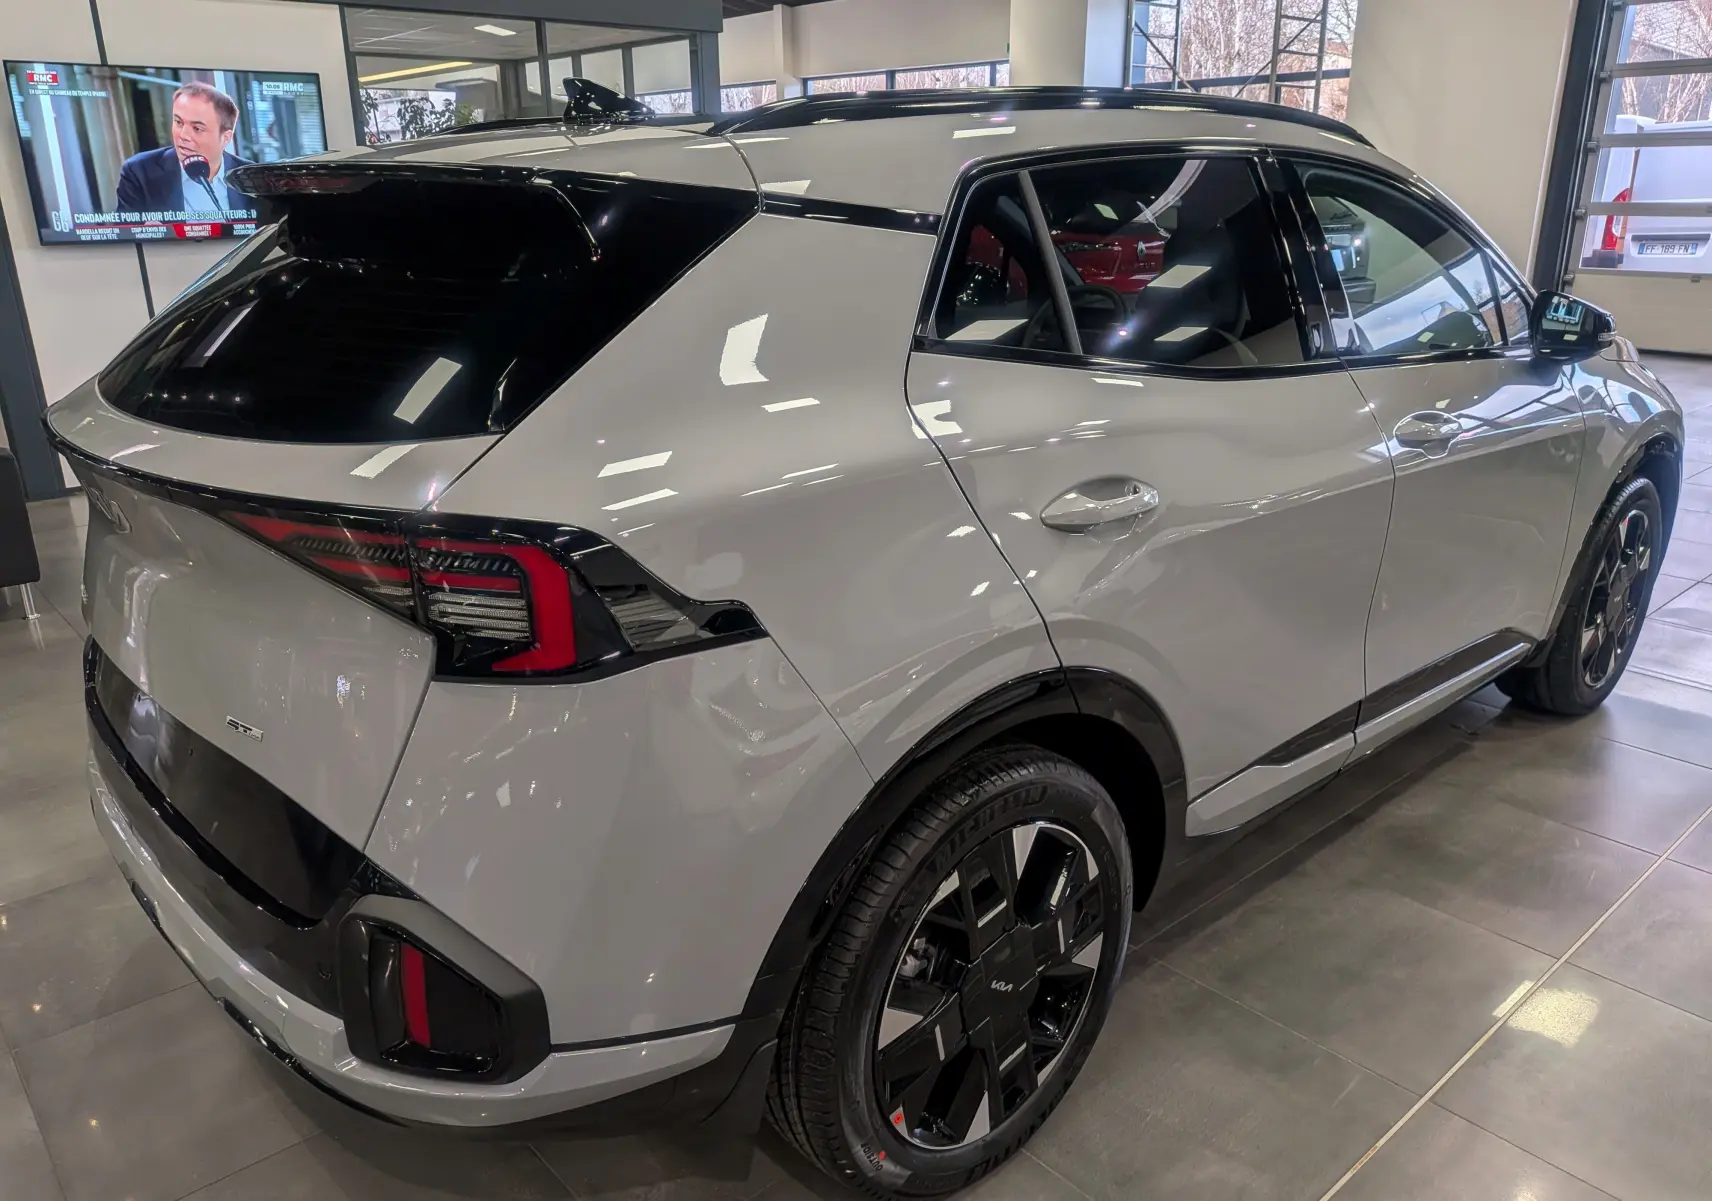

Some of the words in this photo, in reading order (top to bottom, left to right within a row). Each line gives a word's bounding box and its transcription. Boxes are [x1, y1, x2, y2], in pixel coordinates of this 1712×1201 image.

[33, 74, 52, 82] RMC
[284, 82, 303, 92] RMC
[184, 156, 205, 166] RMC
[74, 211, 121, 224] CONDAMNÉE
[121, 211, 141, 223] POUR
[142, 211, 163, 223] AVOIR
[164, 210, 190, 220] DÉLOGE
[191, 211, 204, 220] SES
[204, 210, 248, 220] SQUATTEURS
